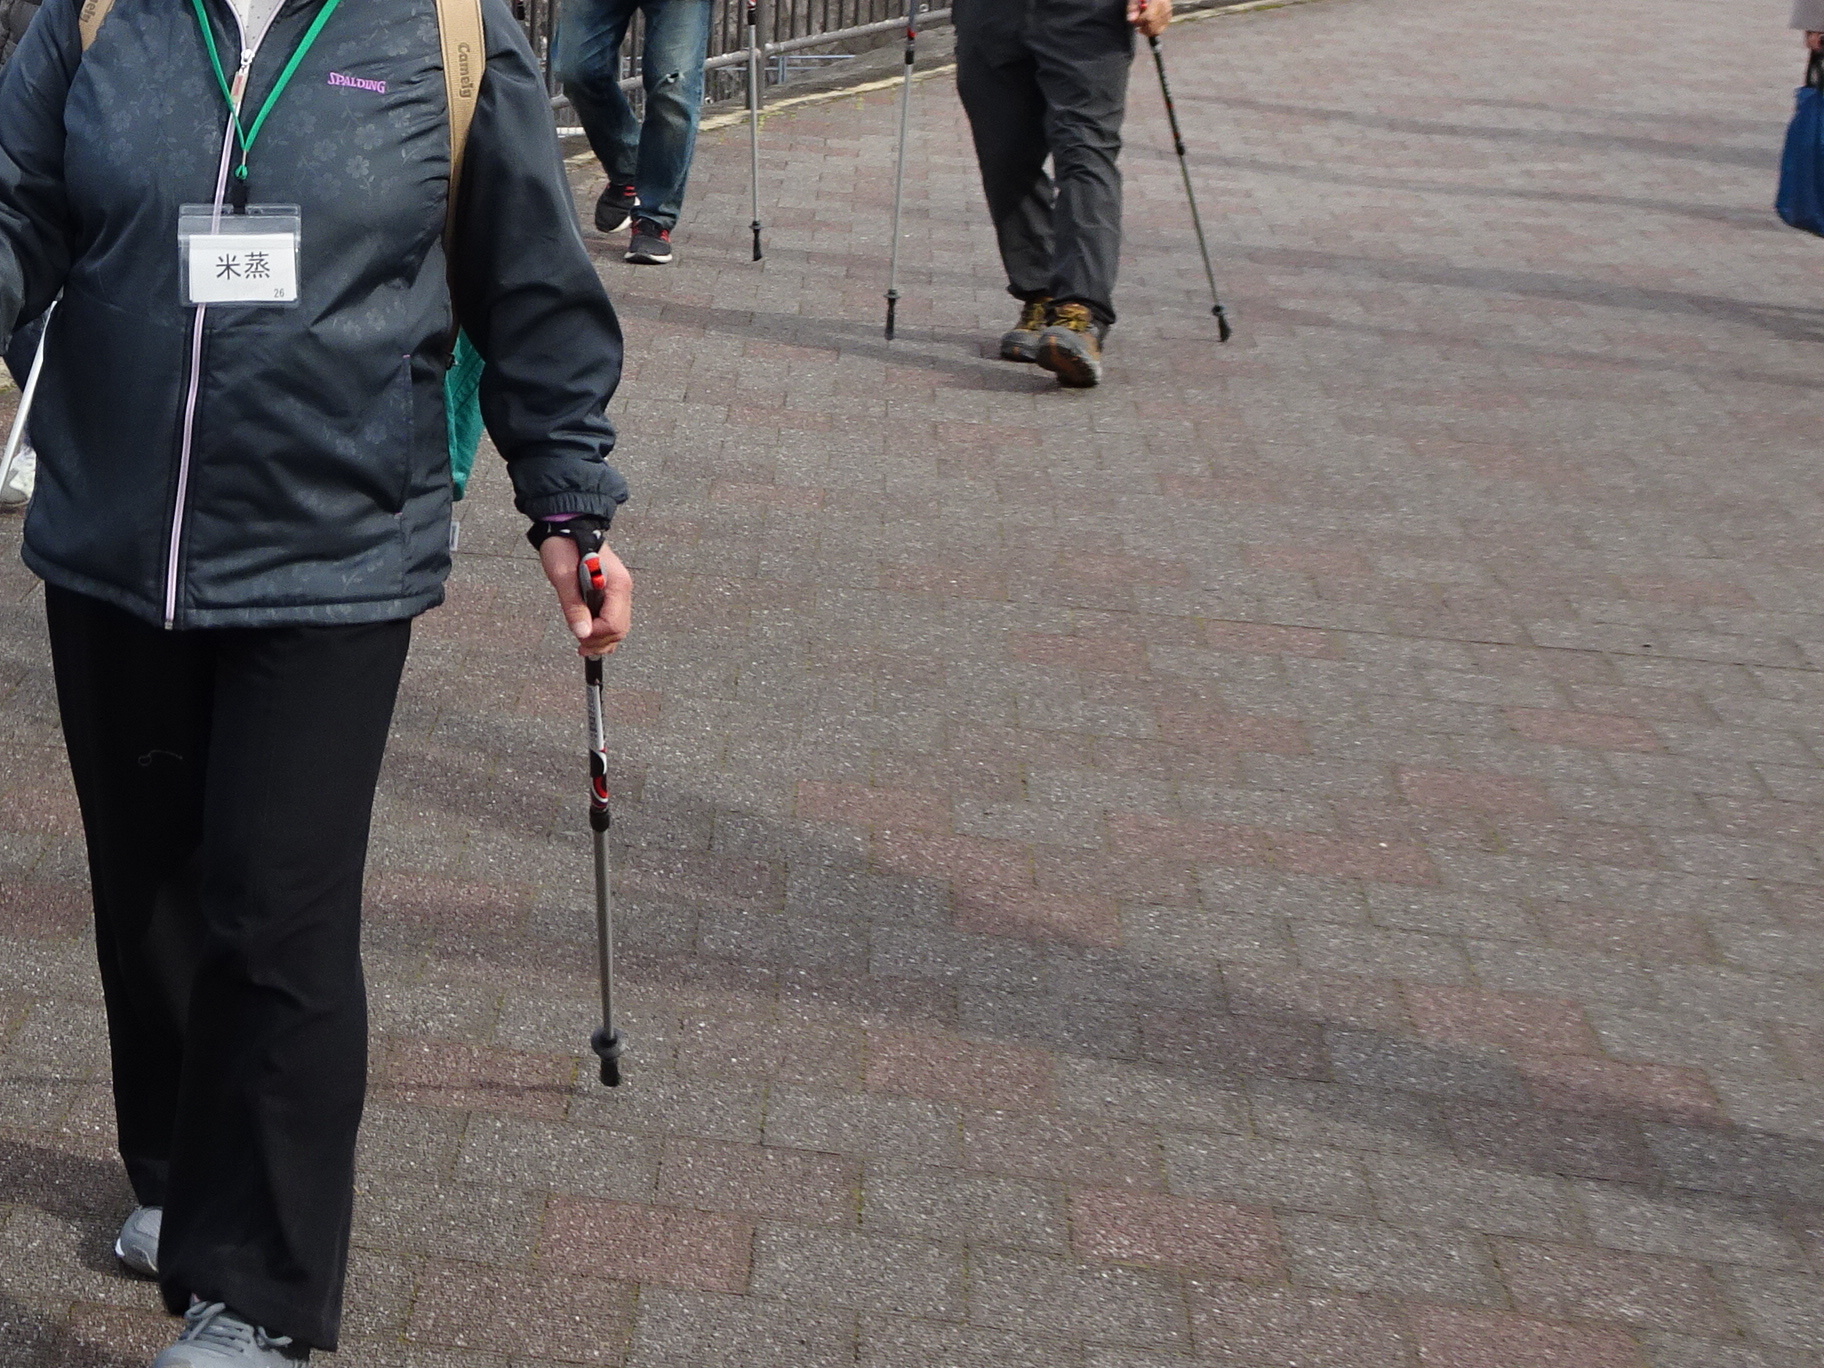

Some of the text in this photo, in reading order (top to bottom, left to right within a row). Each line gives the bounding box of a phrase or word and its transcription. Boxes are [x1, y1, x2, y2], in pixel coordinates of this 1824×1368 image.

[327, 71, 387, 94] SPALDING
[457, 41, 472, 99] Camely
[216, 251, 271, 281] 米蒸
[273, 288, 285, 298] 26
